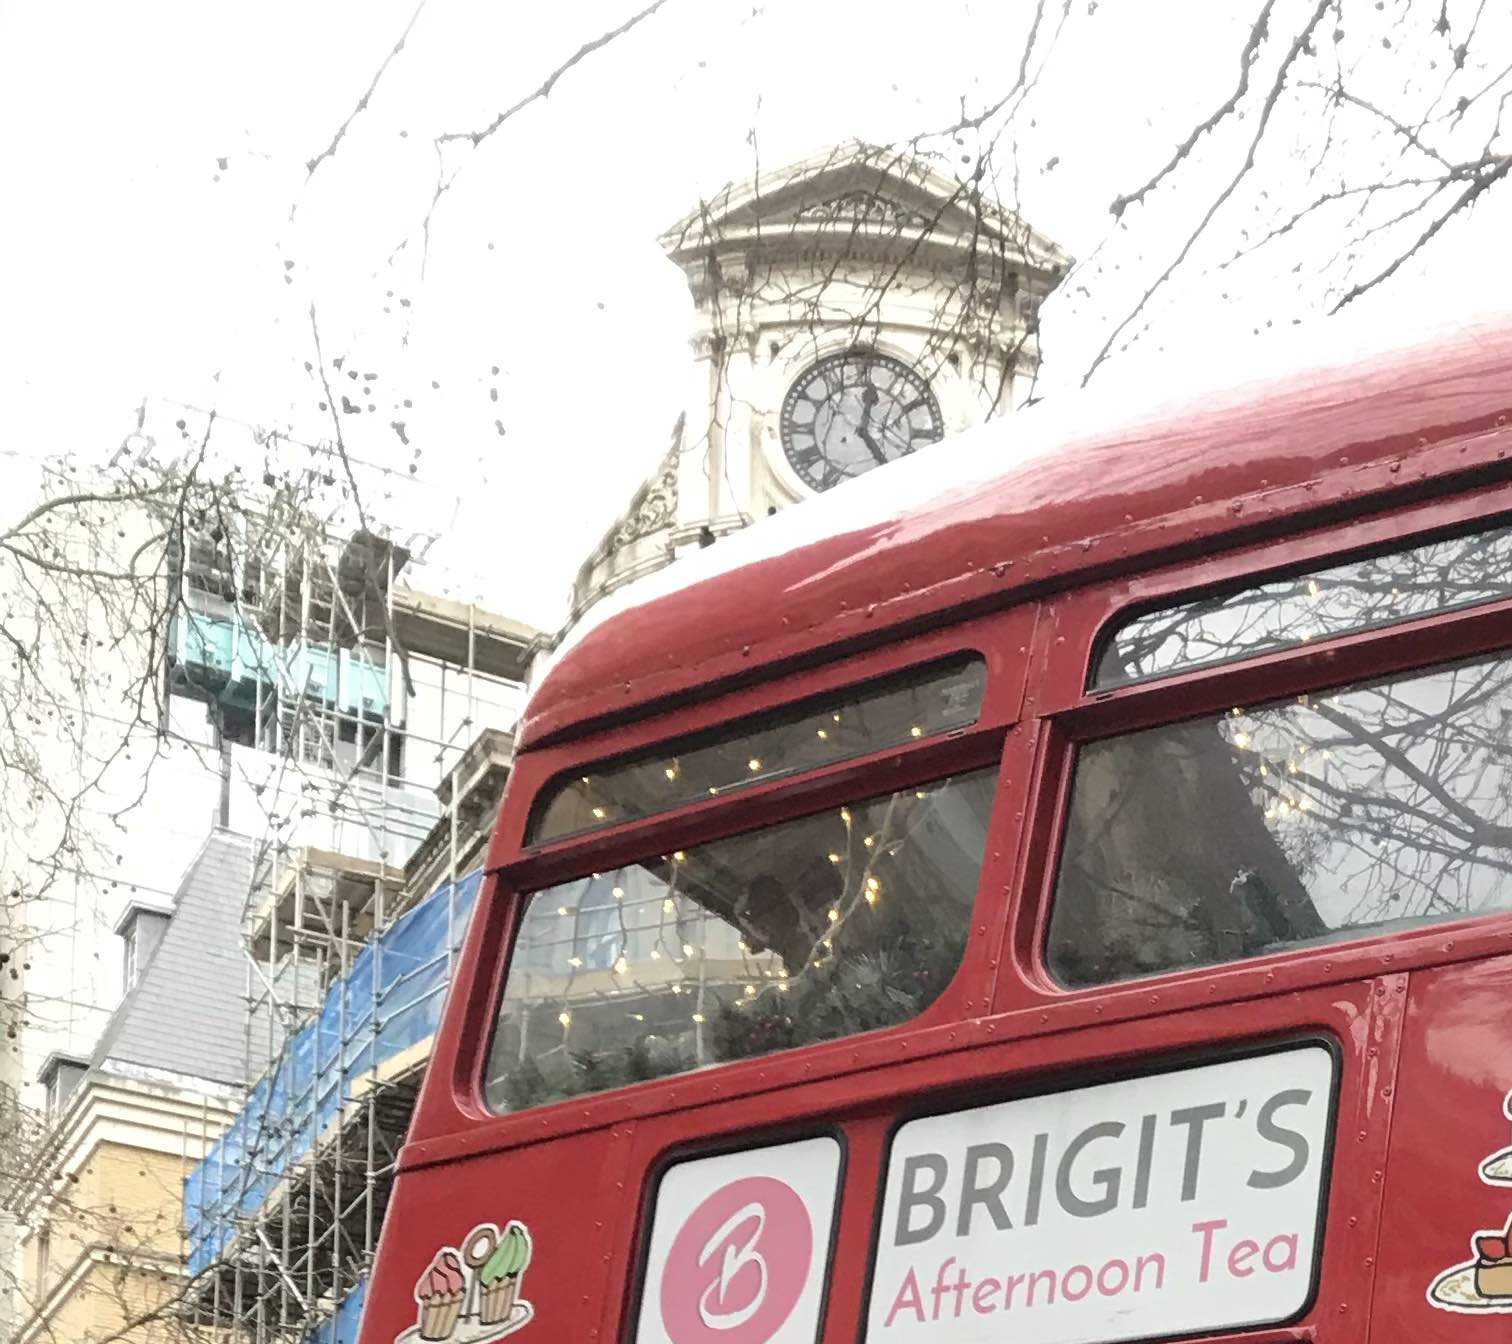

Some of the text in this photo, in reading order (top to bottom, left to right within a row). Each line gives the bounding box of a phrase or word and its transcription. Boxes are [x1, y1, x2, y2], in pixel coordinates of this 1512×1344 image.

[893, 1089, 1312, 1247] BRIGIT'S
[883, 1219, 1300, 1328] Afternoon Tea
